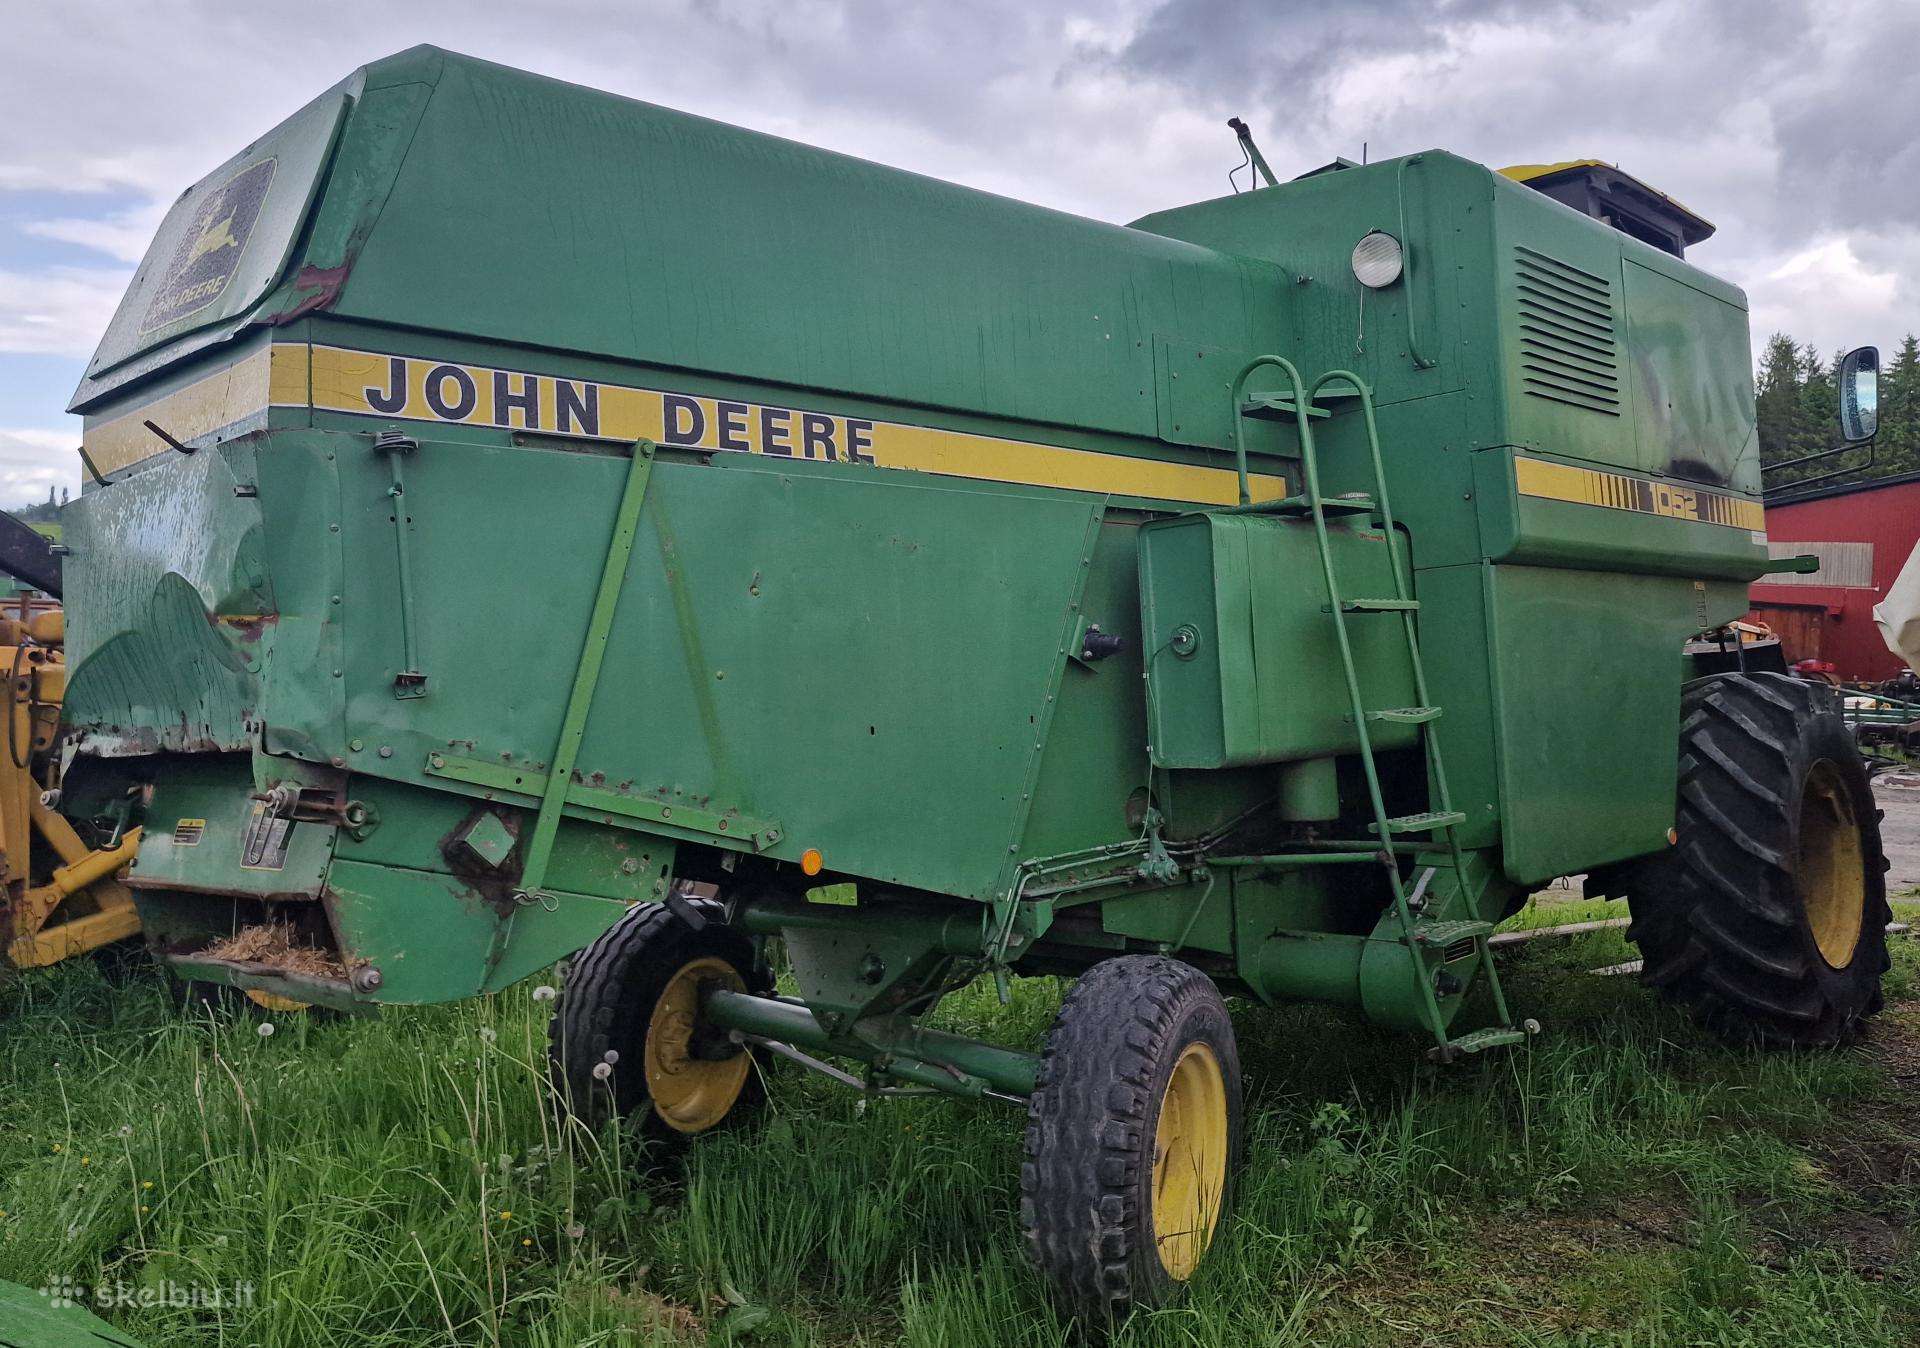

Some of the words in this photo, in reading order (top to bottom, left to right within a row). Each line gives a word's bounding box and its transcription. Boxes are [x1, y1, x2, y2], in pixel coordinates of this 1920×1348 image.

[179, 275, 226, 305] DEERE
[366, 358, 599, 436] JOHN
[664, 394, 875, 463] DEERE
[1650, 483, 1698, 520] 1052
